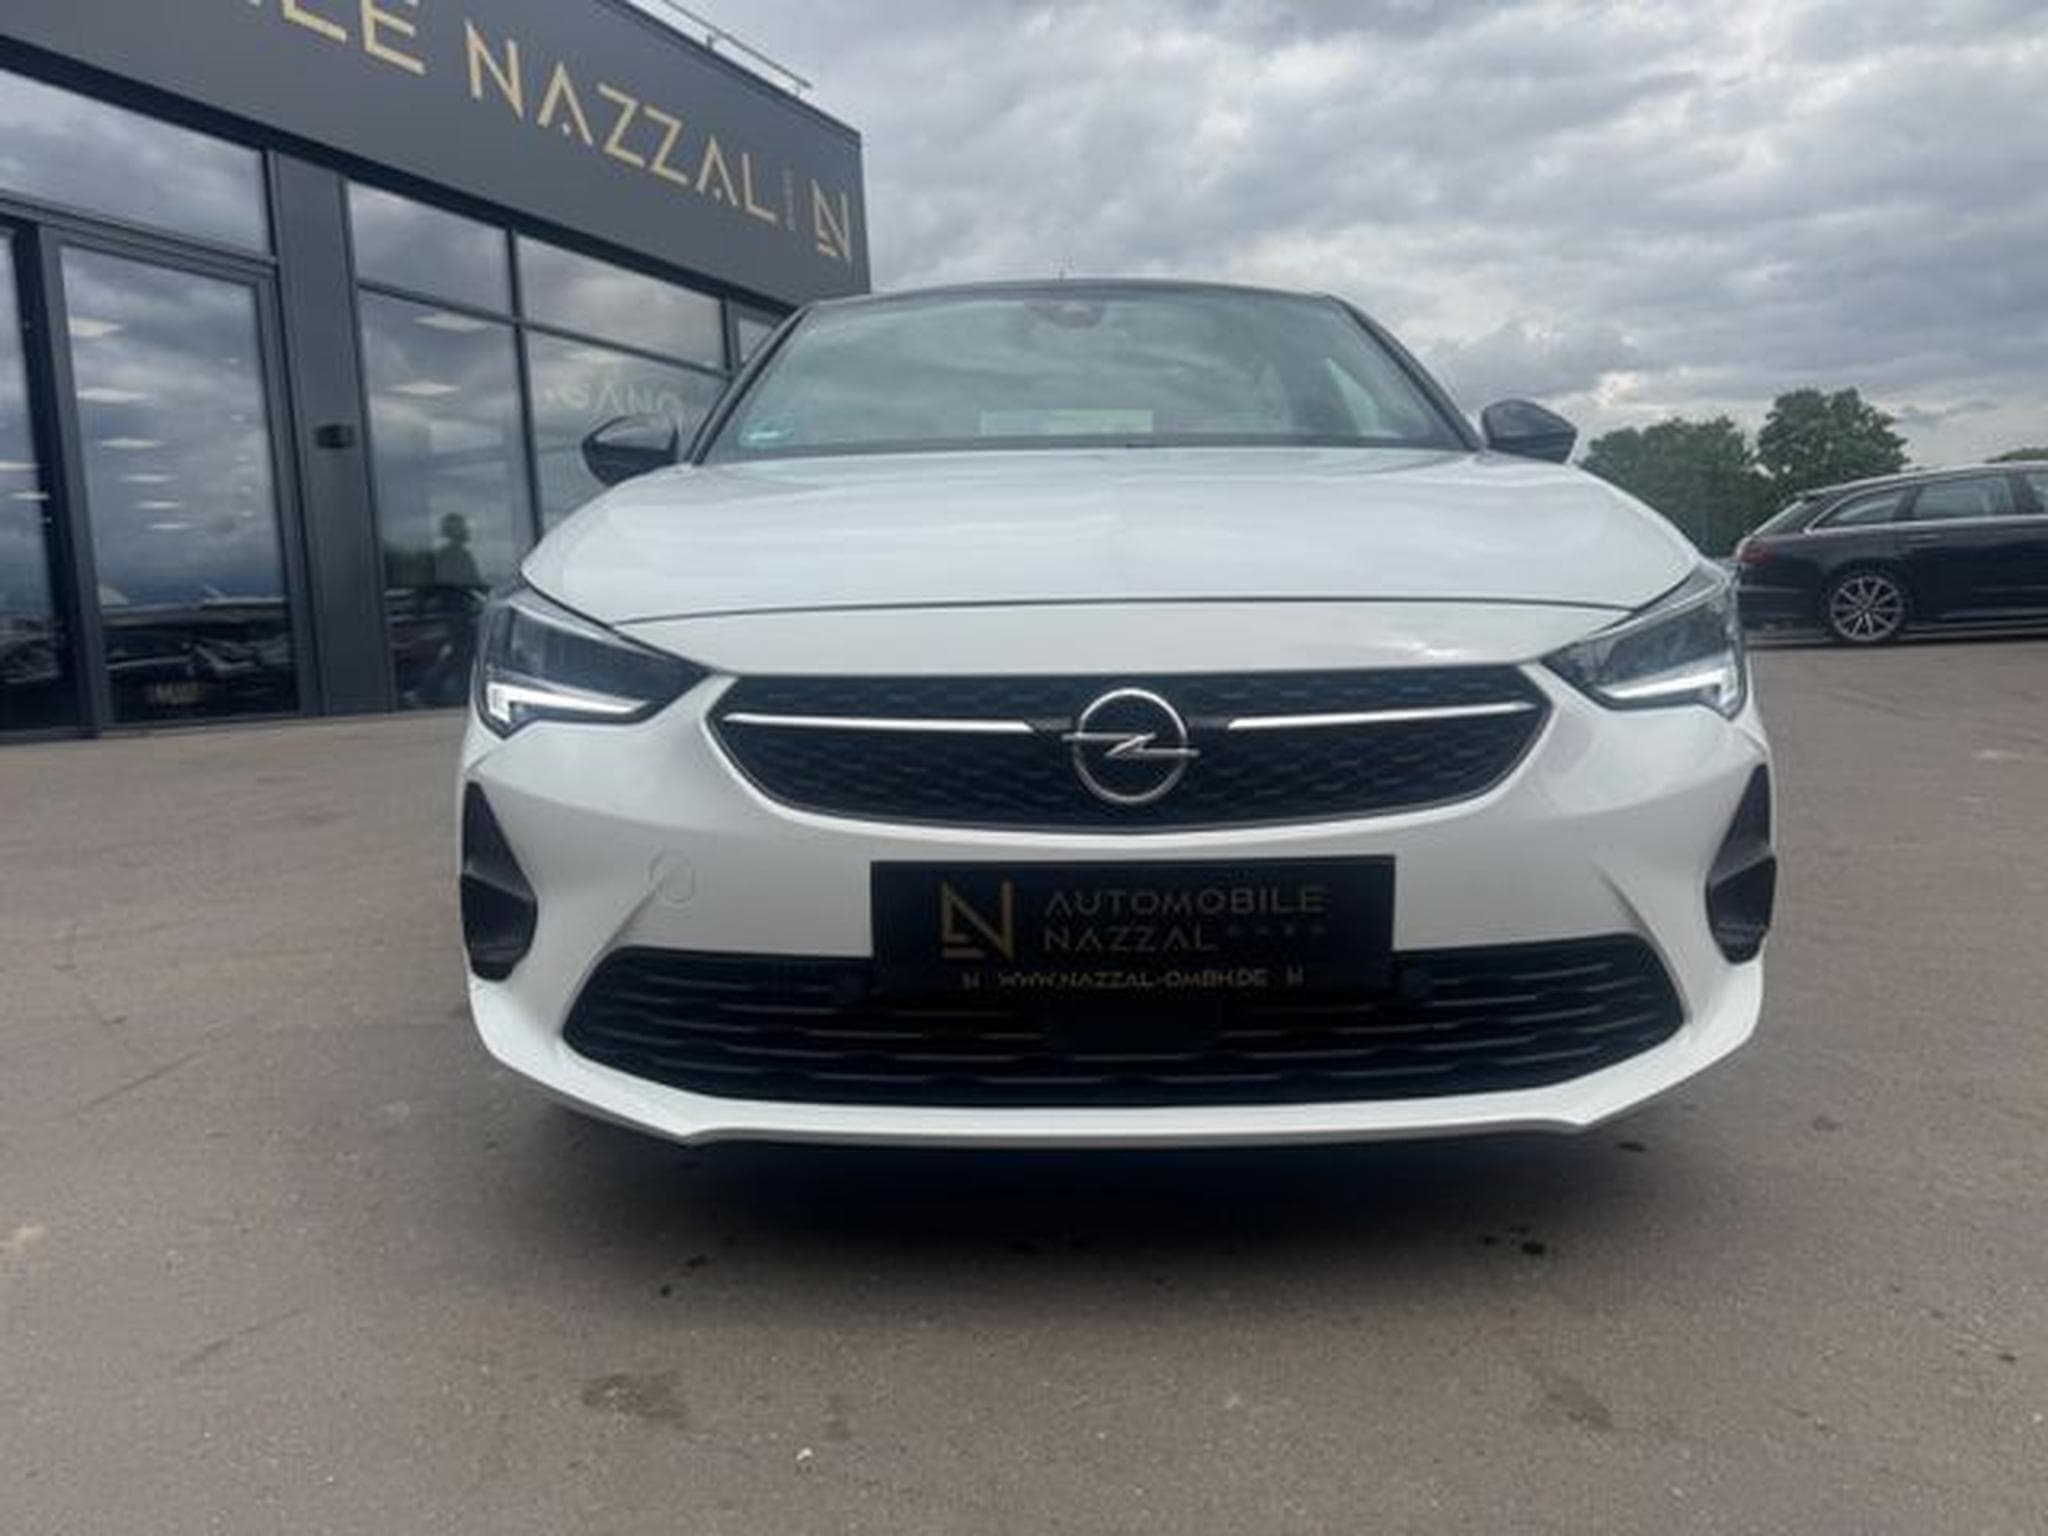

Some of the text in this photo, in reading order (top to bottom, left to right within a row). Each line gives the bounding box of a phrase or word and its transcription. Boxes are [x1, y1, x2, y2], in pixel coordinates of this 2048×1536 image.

[464, 18, 778, 224] NAZZAL
[1043, 886, 1330, 917] AUTOMOBILE
[1043, 924, 1220, 953] NAZZAL
